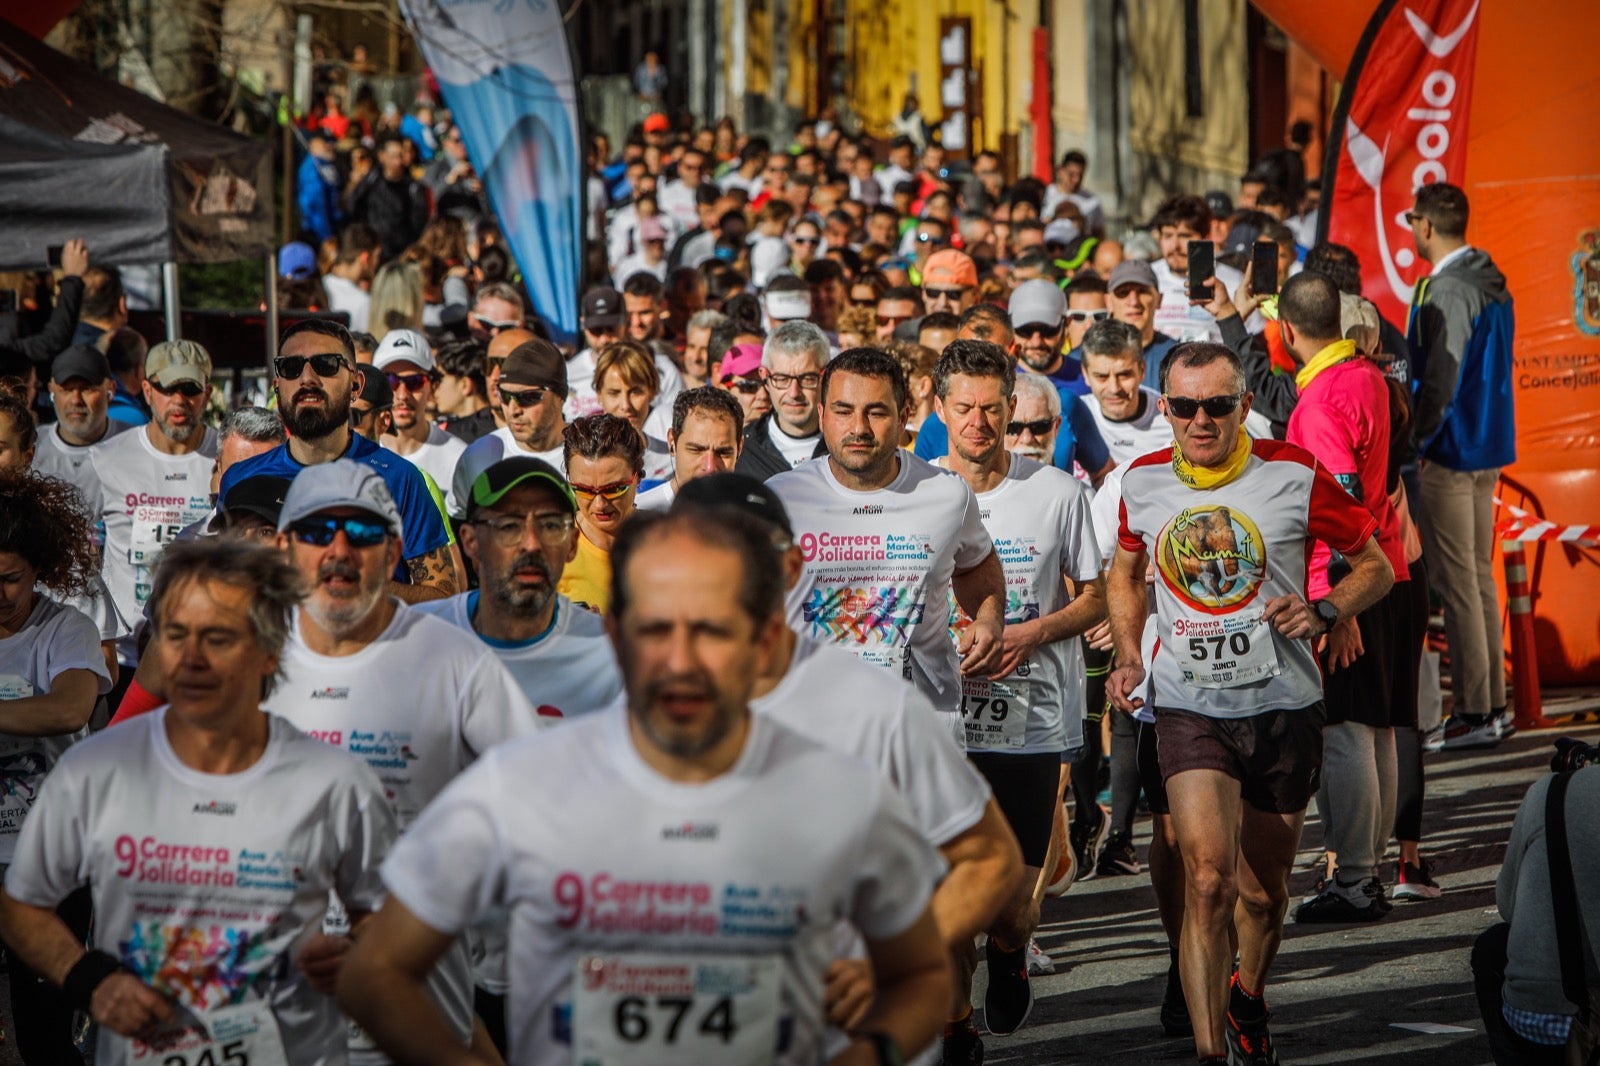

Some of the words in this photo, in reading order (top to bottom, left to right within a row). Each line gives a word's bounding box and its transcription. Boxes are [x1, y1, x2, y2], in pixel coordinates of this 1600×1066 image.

[1395, 70, 1456, 231] polo
[139, 493, 185, 506] Carrera
[852, 506, 884, 516] Altium
[886, 534, 906, 542] Ave
[994, 538, 1012, 546] Ave
[800, 533, 818, 562] 9
[819, 532, 881, 547] Carrera
[818, 547, 885, 562] Solidaria
[886, 551, 928, 560] Granada
[1001, 554, 1034, 563] ranada
[1168, 531, 1257, 597] Mamut
[816, 574, 846, 583] Mirando
[847, 574, 875, 584] siempre
[876, 573, 897, 582] hacia
[898, 572, 906, 582] lo
[906, 572, 920, 582] alto
[1175, 618, 1186, 636] 9
[1185, 619, 1220, 629] Carrera
[1185, 627, 1225, 637] Solidaria
[1224, 624, 1254, 634] Granada
[1189, 632, 1251, 661] 570
[1212, 660, 1237, 671] JUNCO
[963, 680, 989, 689] rrera
[964, 688, 990, 697] daria
[0, 808, 28, 819] ERTA
[115, 835, 137, 879] 9
[139, 836, 230, 864] Carrera
[138, 860, 236, 888] Solidaria
[553, 872, 585, 929] 9
[588, 872, 712, 905] Carrera
[586, 906, 720, 935] Solidaria
[612, 996, 739, 1045] 674
